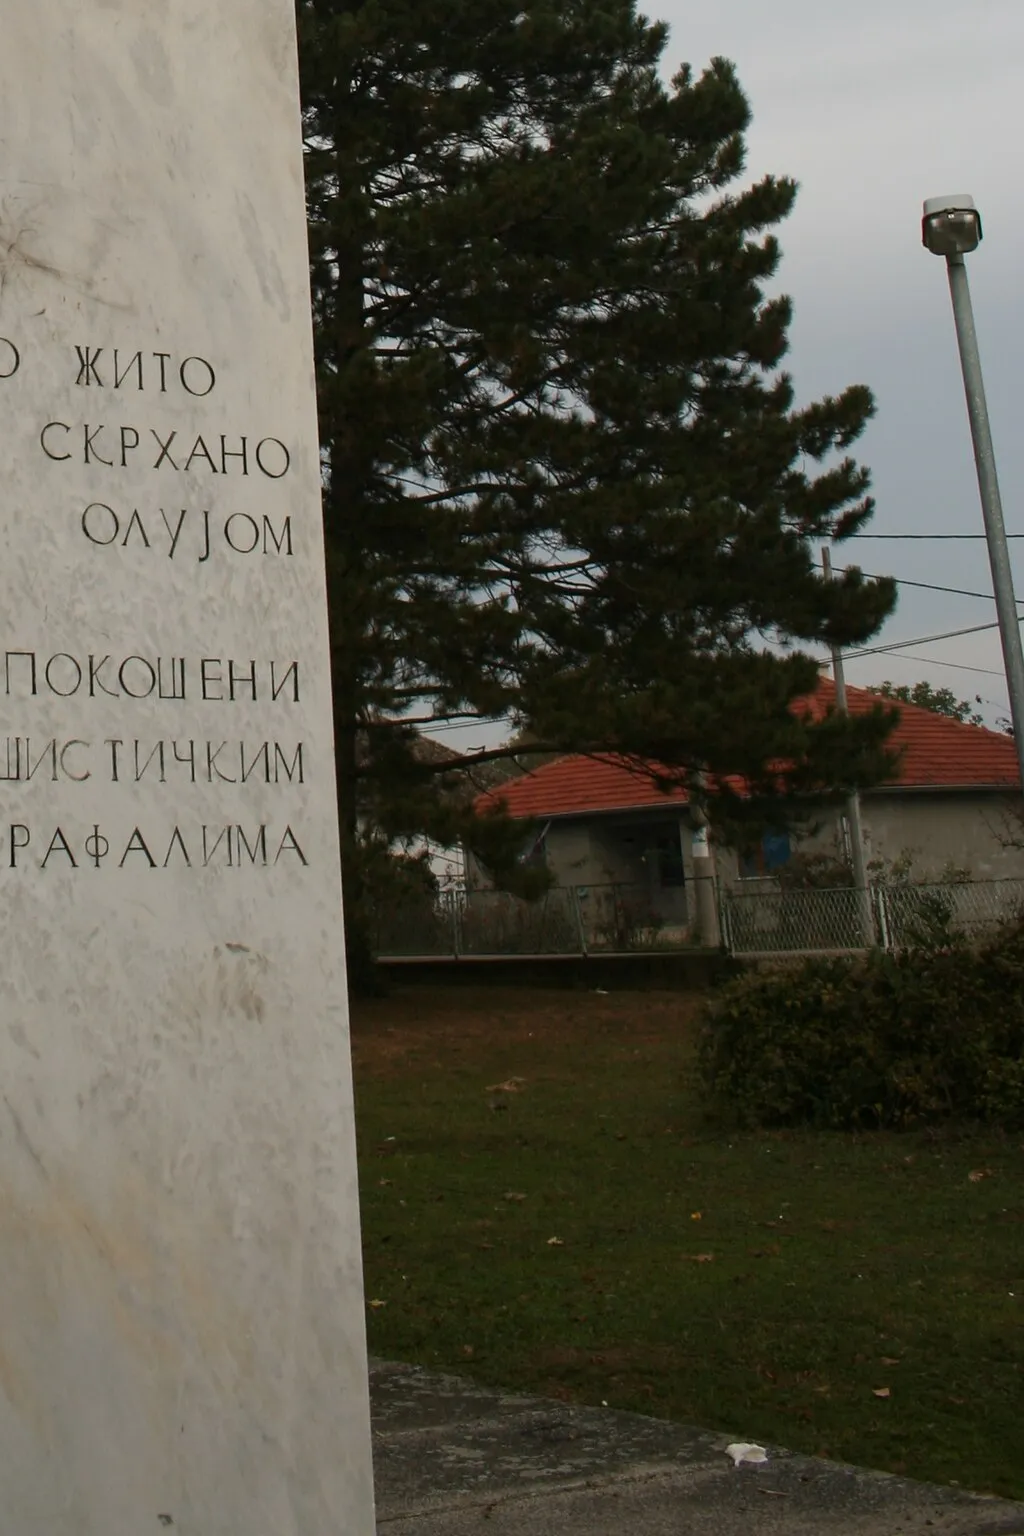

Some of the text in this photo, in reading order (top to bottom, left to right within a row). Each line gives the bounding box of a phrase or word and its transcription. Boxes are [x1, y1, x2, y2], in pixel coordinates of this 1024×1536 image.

[74, 344, 216, 397] ЖИТО
[40, 421, 291, 480] СКРХАНО
[80, 502, 294, 564] ОЛУЈОМ
[4, 651, 301, 703] ПОКОШЕНИ
[8, 823, 310, 870] РАФАЛИМА
